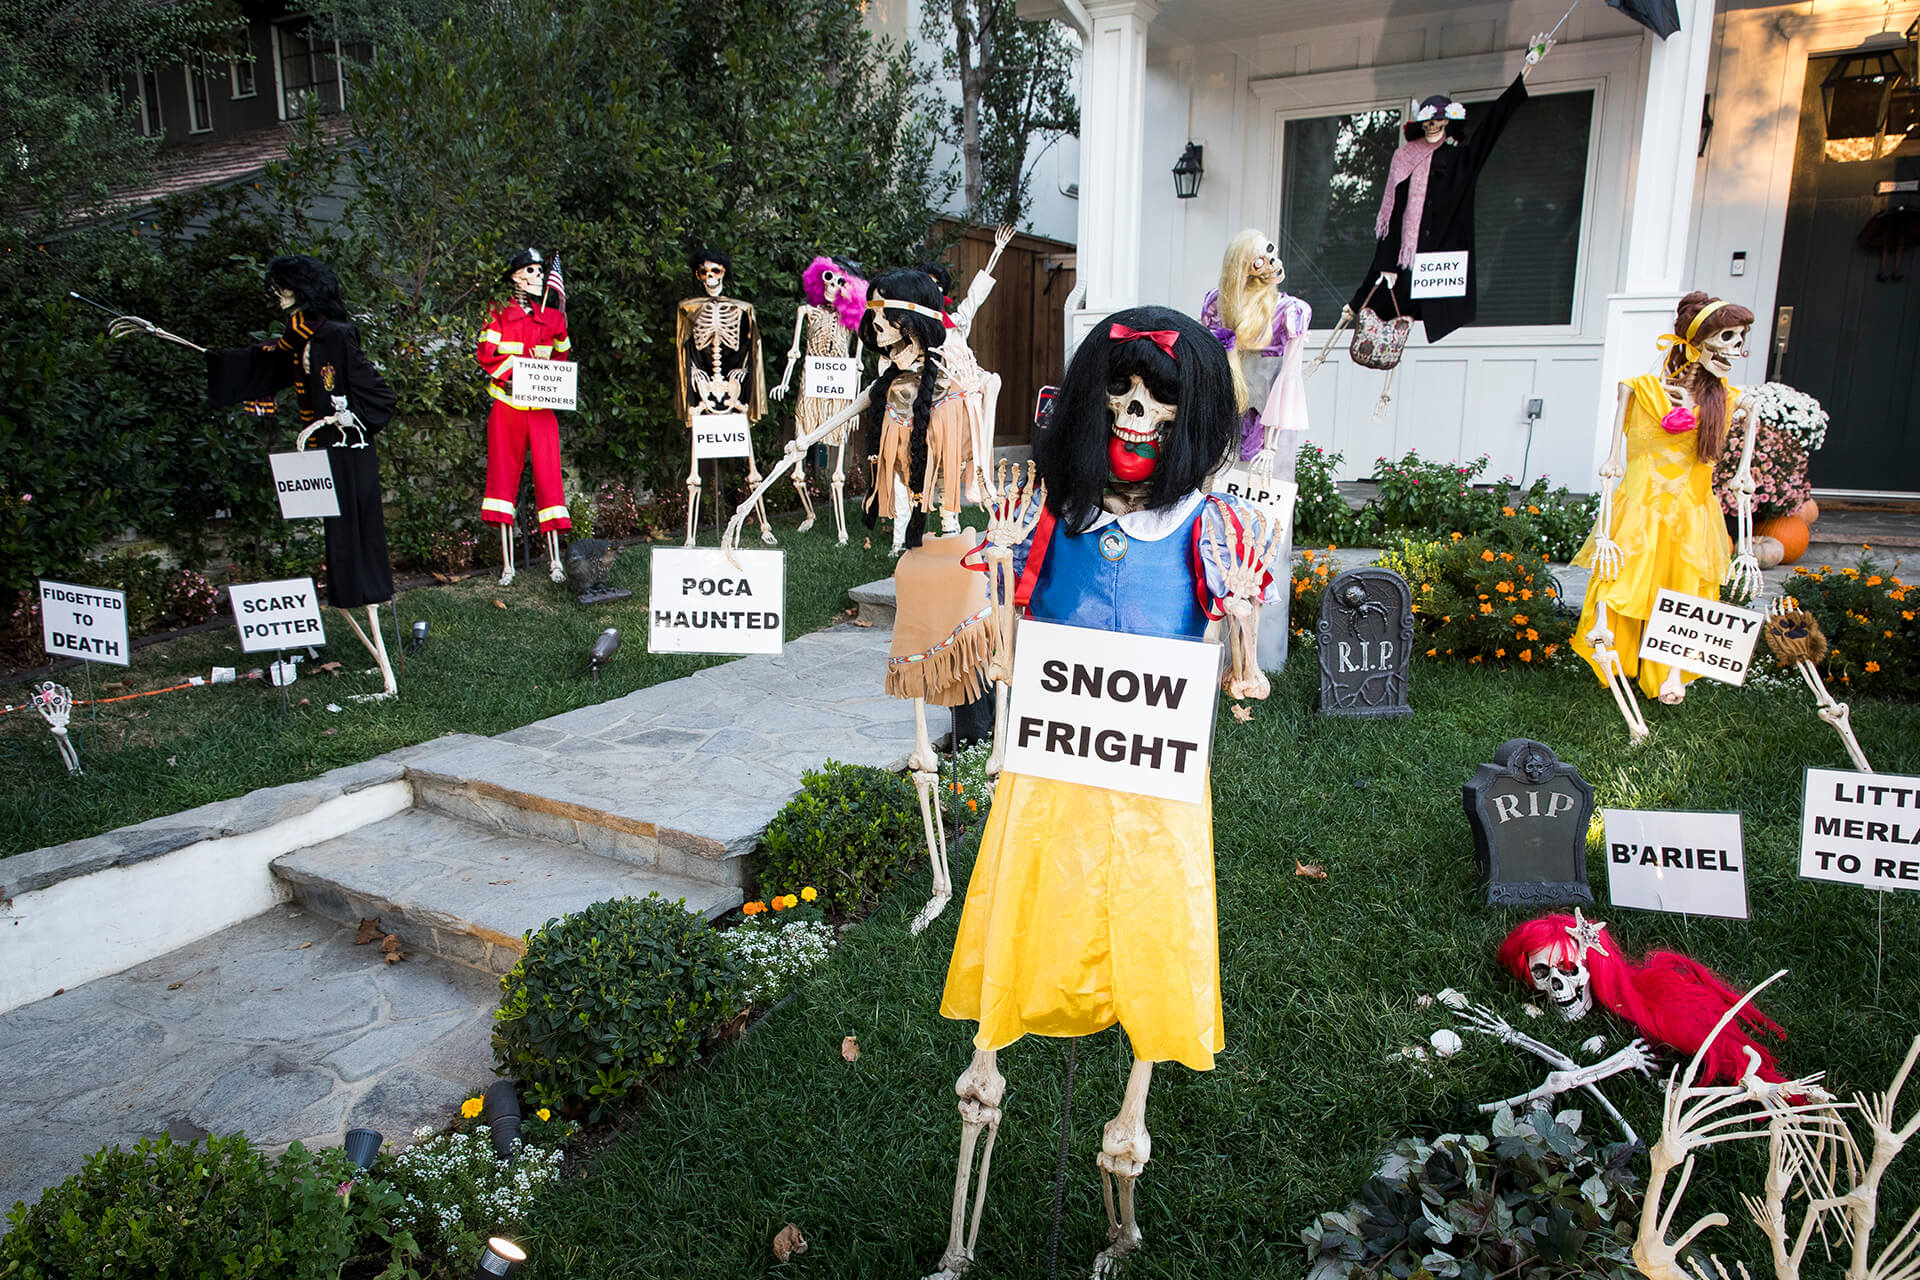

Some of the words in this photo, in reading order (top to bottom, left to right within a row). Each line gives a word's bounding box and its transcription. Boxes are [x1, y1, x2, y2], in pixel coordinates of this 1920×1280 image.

[1420, 261, 1459, 272] SCARY
[1413, 277, 1465, 288] POPPINS
[520, 362, 550, 370] THANK
[554, 364, 572, 372] YOU
[814, 362, 847, 371] DISCO
[514, 394, 574, 404] RESPONDERS
[816, 386, 844, 394] DEAD
[697, 432, 746, 444] PELVIS
[278, 478, 332, 492] DEADWIG
[682, 578, 752, 596] POCA
[43, 588, 122, 610] FIDGETTED
[242, 594, 306, 614] SCARY
[72, 612, 94, 626] TO
[655, 610, 780, 630] HAUNTED
[1658, 598, 1757, 634] BEAUTY
[244, 618, 320, 638] POTTER
[1667, 624, 1698, 640] AND
[1704, 634, 1734, 650] THE
[52, 632, 119, 656] DEATH
[1338, 641, 1394, 672] R.I.P.
[1646, 637, 1744, 673] DECEASED
[1040, 660, 1187, 710] SNOW
[1018, 716, 1198, 774] FRIGHT
[1492, 791, 1574, 824] RIP
[1612, 843, 1738, 872] B'ARIEL
[1815, 851, 1862, 874] TO
